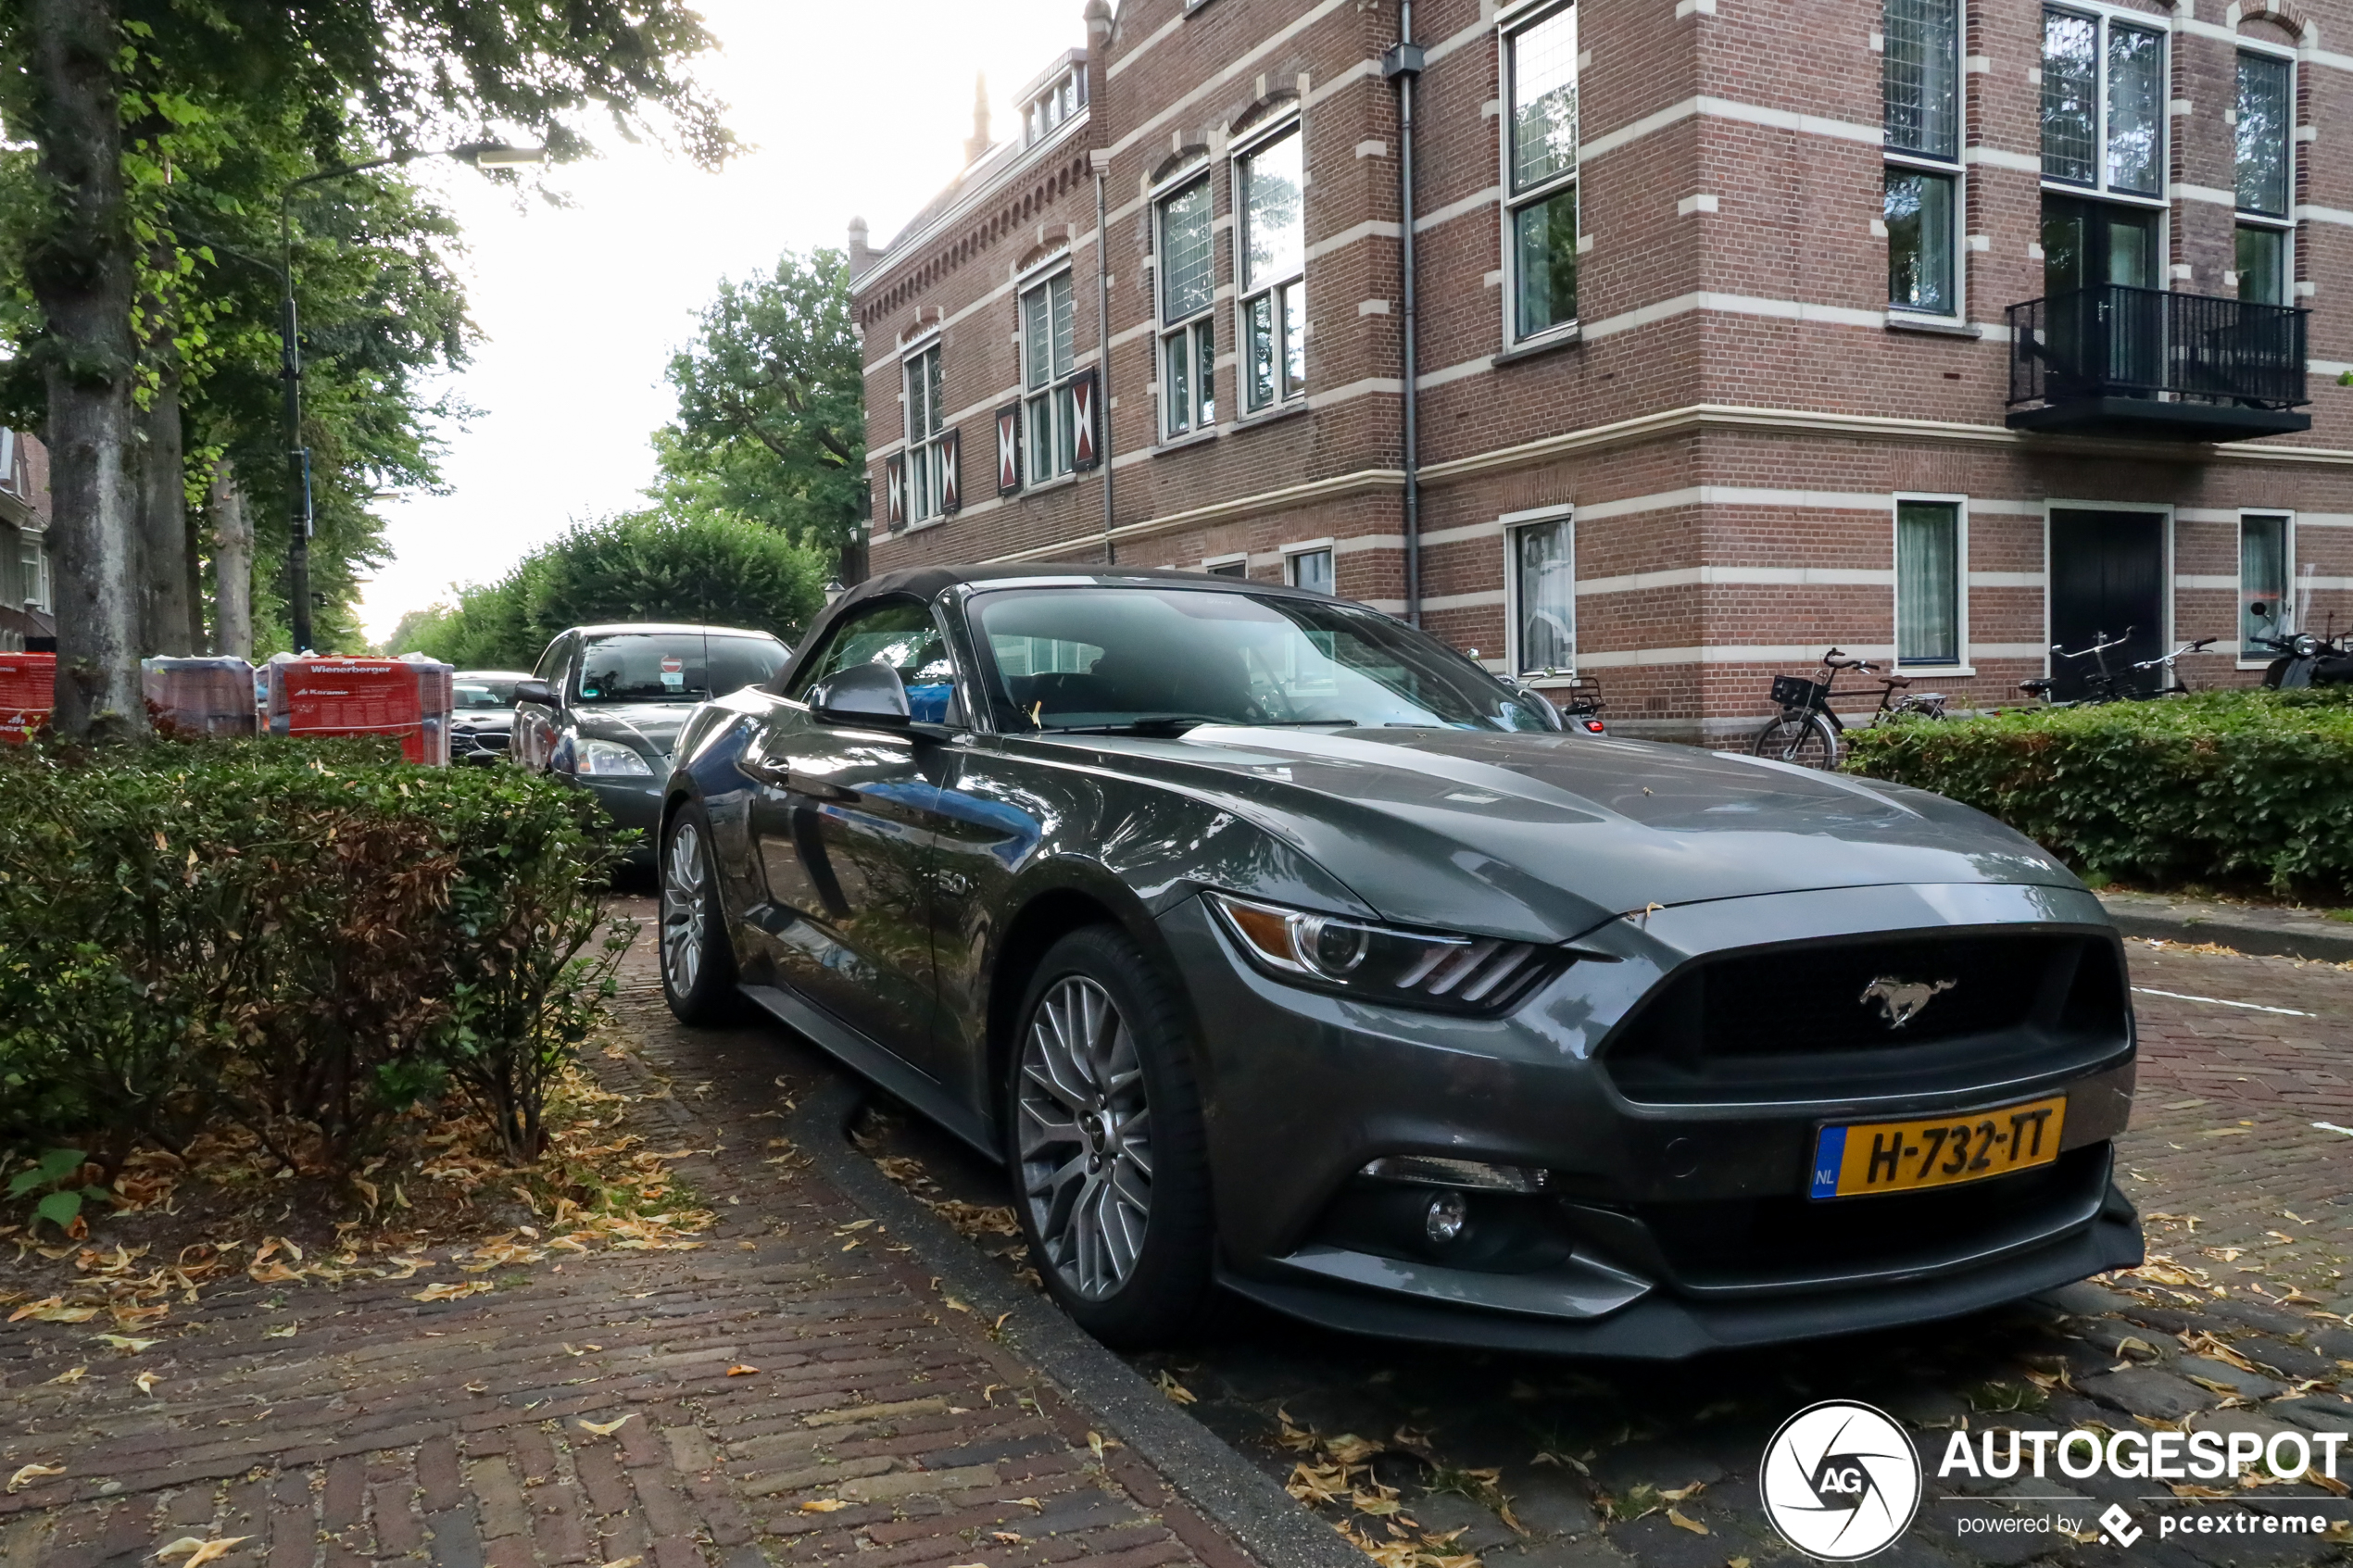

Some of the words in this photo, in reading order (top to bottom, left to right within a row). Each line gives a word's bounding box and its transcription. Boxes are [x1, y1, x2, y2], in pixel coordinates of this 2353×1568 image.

[310, 665, 392, 674] Wienerberger
[1867, 1108, 2053, 1185] H-732-TT
[1816, 1169, 1835, 1185] NL
